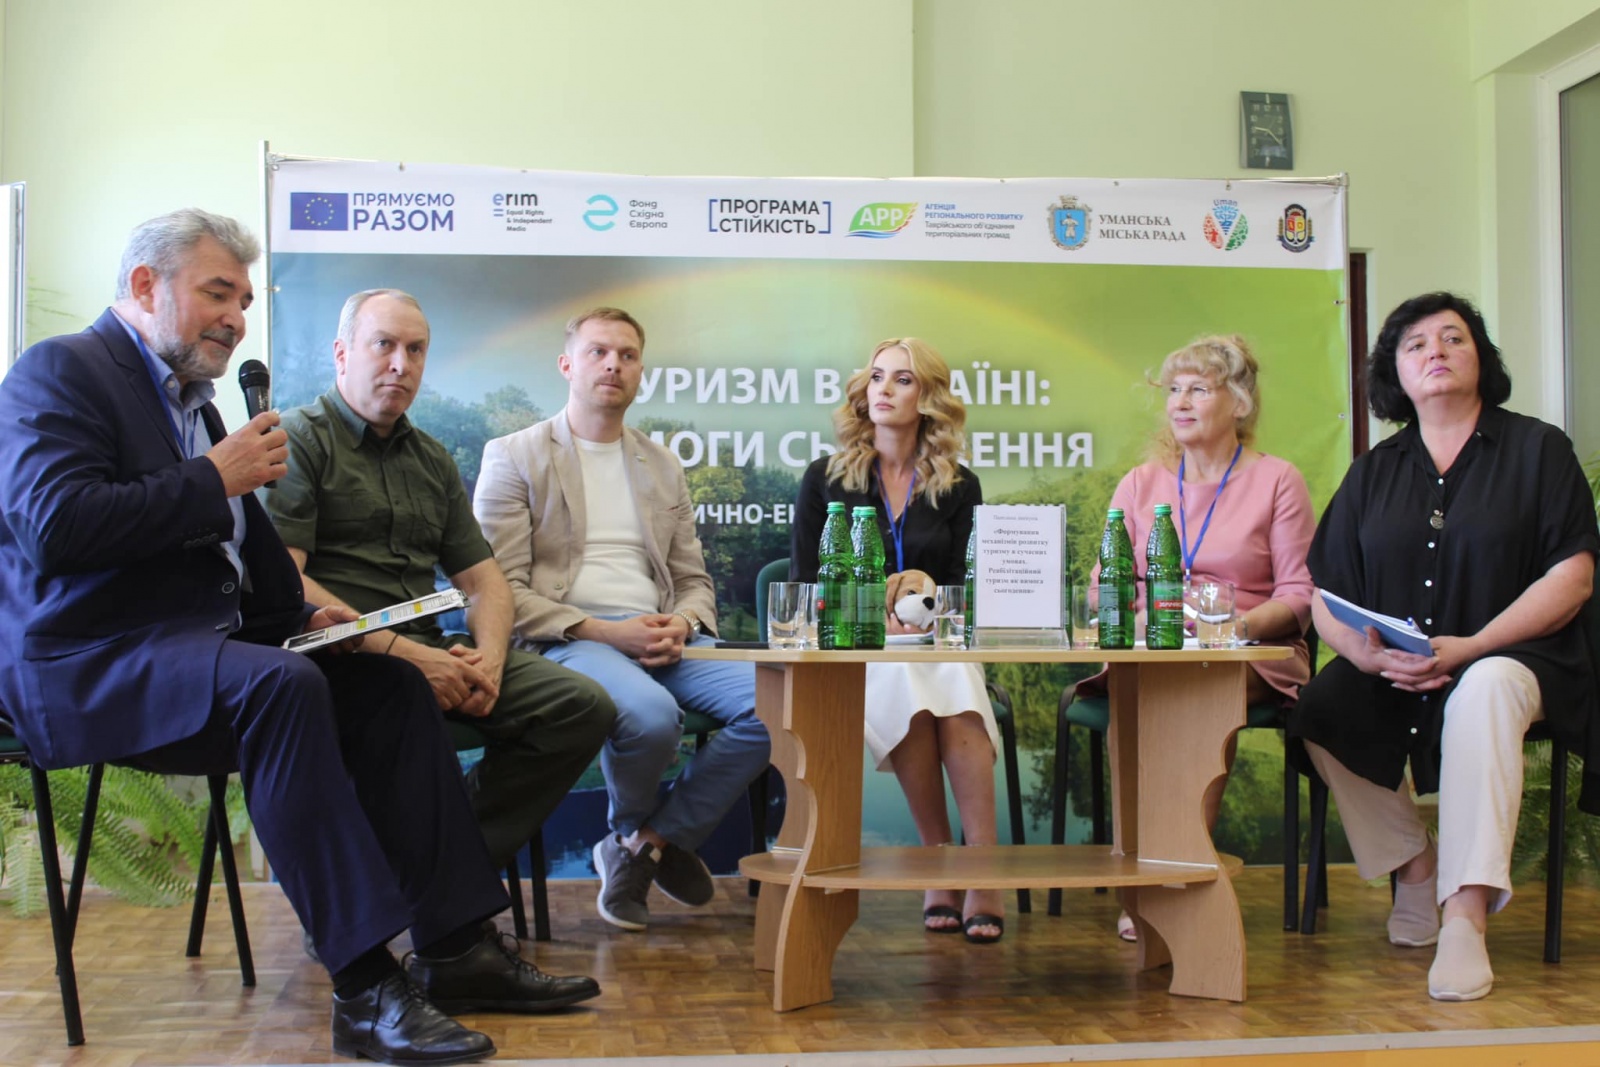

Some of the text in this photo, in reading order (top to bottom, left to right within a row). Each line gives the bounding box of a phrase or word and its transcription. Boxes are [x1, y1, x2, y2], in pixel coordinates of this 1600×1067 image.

[353, 193, 455, 207] ПРЯМУЄМО
[629, 200, 657, 209] Фонд
[720, 199, 820, 215] ПРОГРАМА
[925, 203, 956, 211] АГЕНЦІЯ
[525, 209, 544, 217] Rights
[629, 210, 664, 220] Східна
[925, 212, 1024, 221] РЕГІОНАЛЬНОГО РОЗВИТКУ
[353, 209, 454, 231] РАЗОМ
[629, 220, 668, 230] Європа
[719, 215, 816, 234] СТІЙКІСТЬ
[1099, 214, 1172, 226] УМАНСЬКА
[925, 221, 973, 230] Таврійського
[925, 231, 1011, 240] територіальних громад
[1099, 229, 1186, 242] МІСЬКА РАДА
[635, 367, 800, 405] УРИЗМ
[814, 368, 842, 405] В
